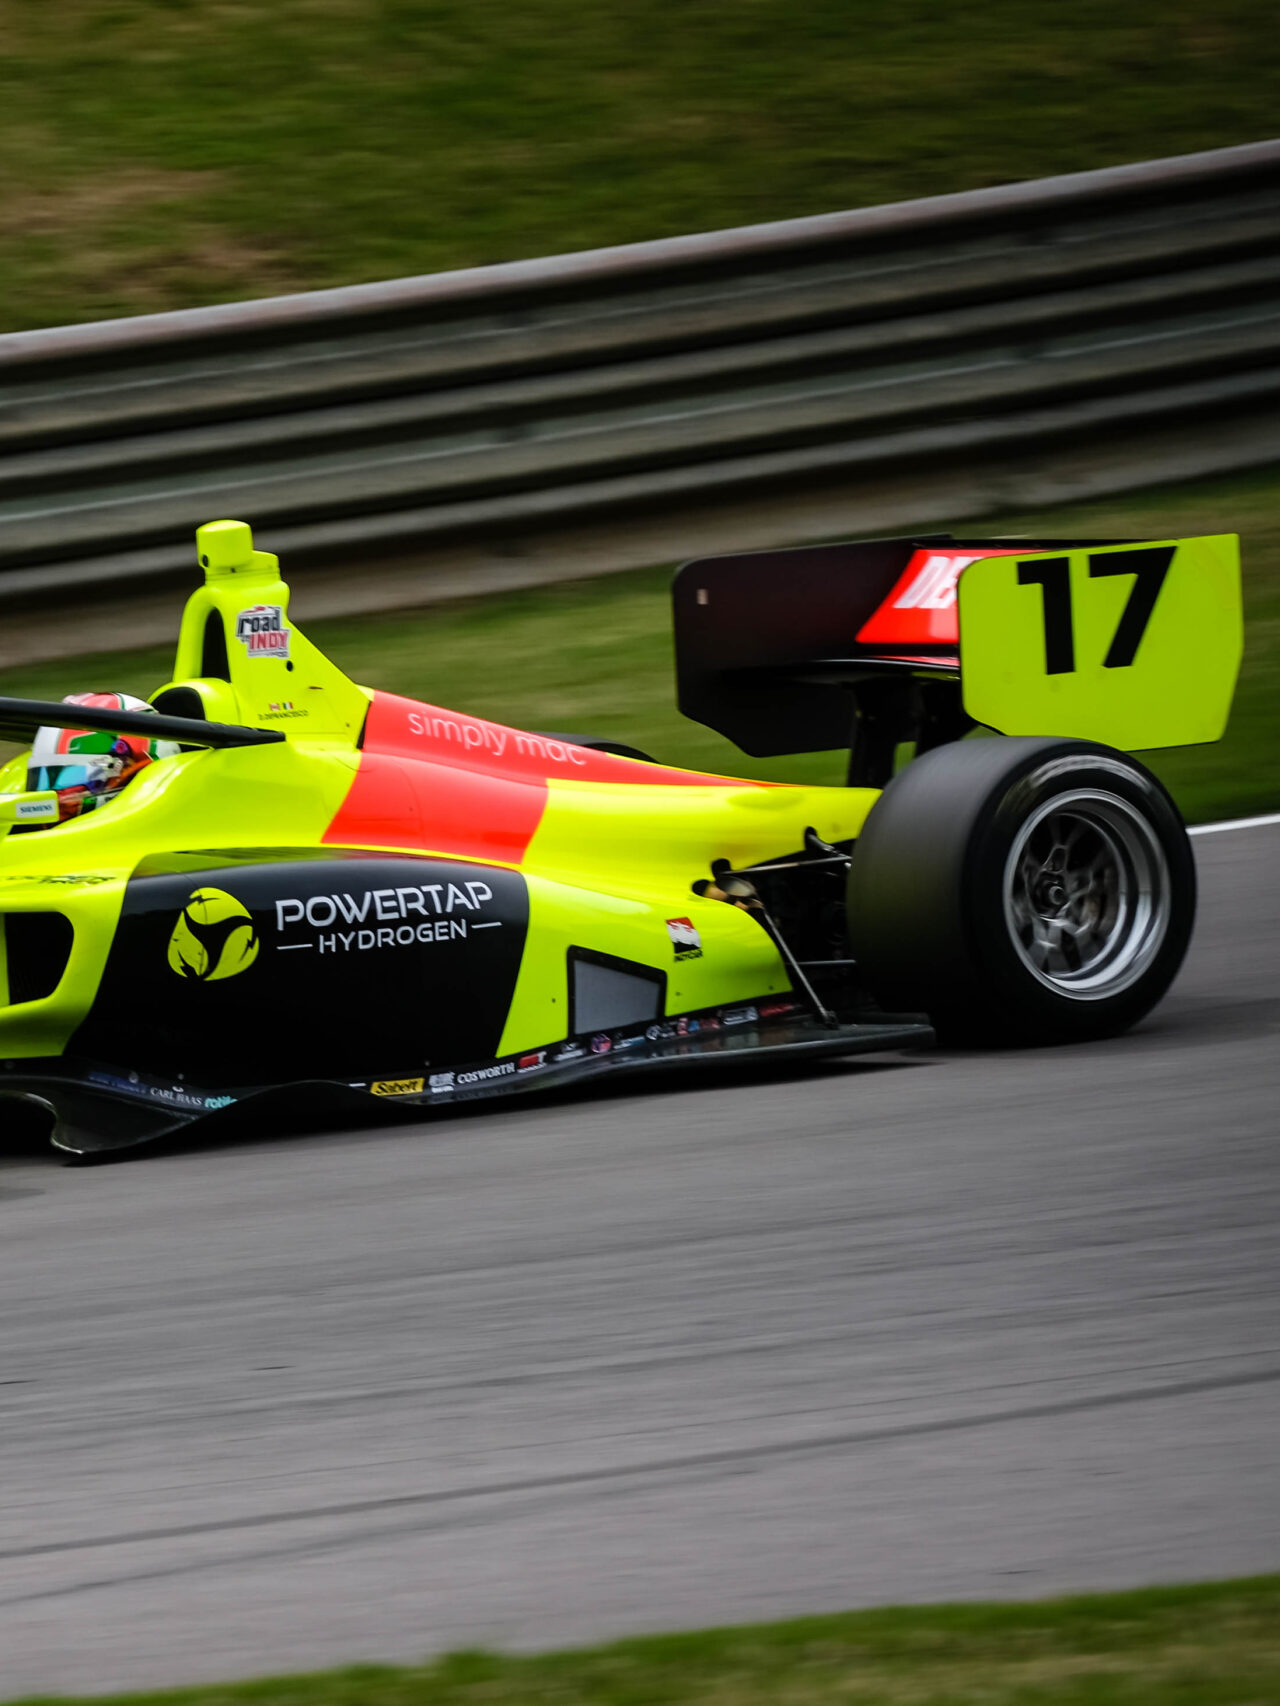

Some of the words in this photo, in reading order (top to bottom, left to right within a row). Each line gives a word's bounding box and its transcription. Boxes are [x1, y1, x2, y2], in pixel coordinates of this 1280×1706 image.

[1016, 545, 1179, 675] 17
[249, 632, 288, 650] INDY
[407, 711, 507, 757] simply
[514, 735, 588, 766] mac
[19, 804, 53, 814] SIEMENS
[275, 881, 494, 931] POWERTAP
[319, 918, 468, 954] HYDROGEN
[457, 1062, 516, 1084] COSWORTH
